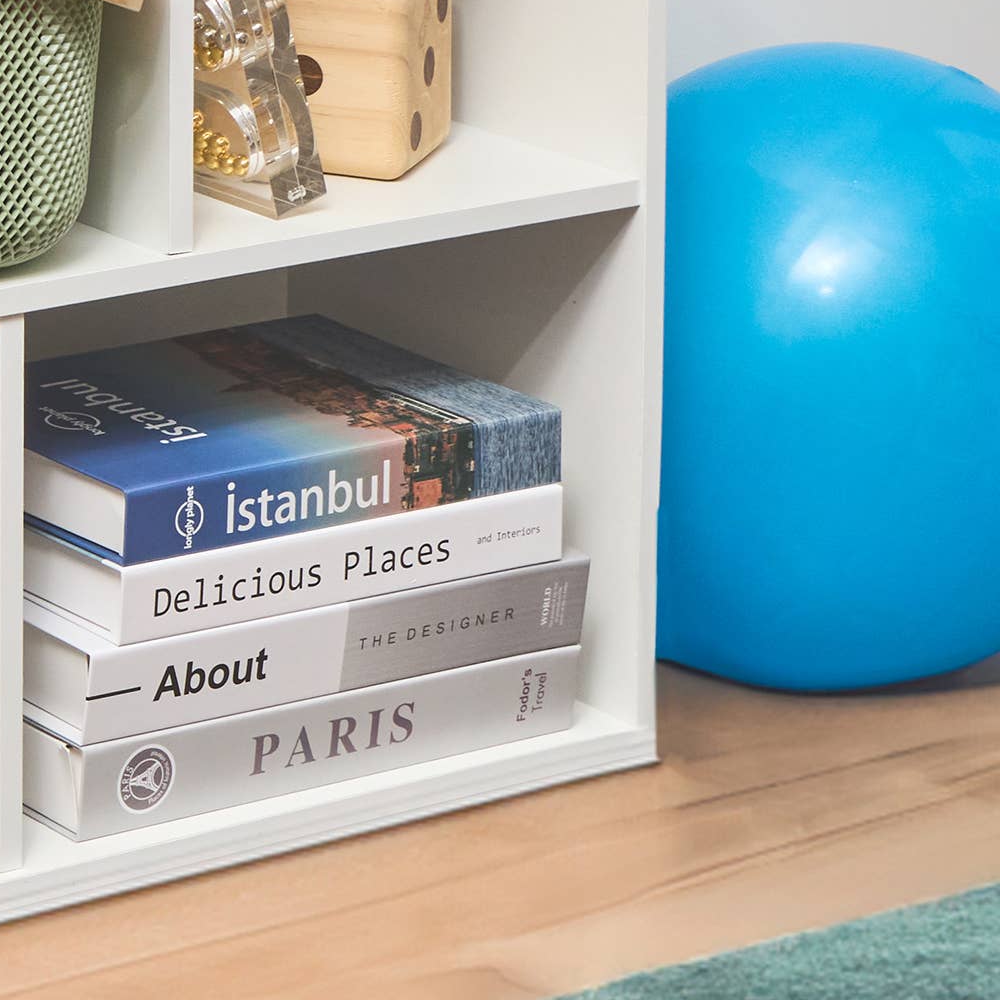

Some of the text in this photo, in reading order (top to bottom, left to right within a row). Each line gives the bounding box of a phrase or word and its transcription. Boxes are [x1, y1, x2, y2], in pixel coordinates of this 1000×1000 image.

[185, 485, 195, 517] planet
[477, 526, 541, 544] and Interiors
[153, 538, 451, 617] Delicious Places
[540, 587, 552, 626] WORLD
[359, 607, 515, 650] THE DESIGNER
[153, 648, 268, 702] About
[516, 668, 532, 722] Fodor's
[531, 672, 547, 713] Travel
[249, 702, 415, 777] PARIS
[121, 765, 135, 801] PARIS
